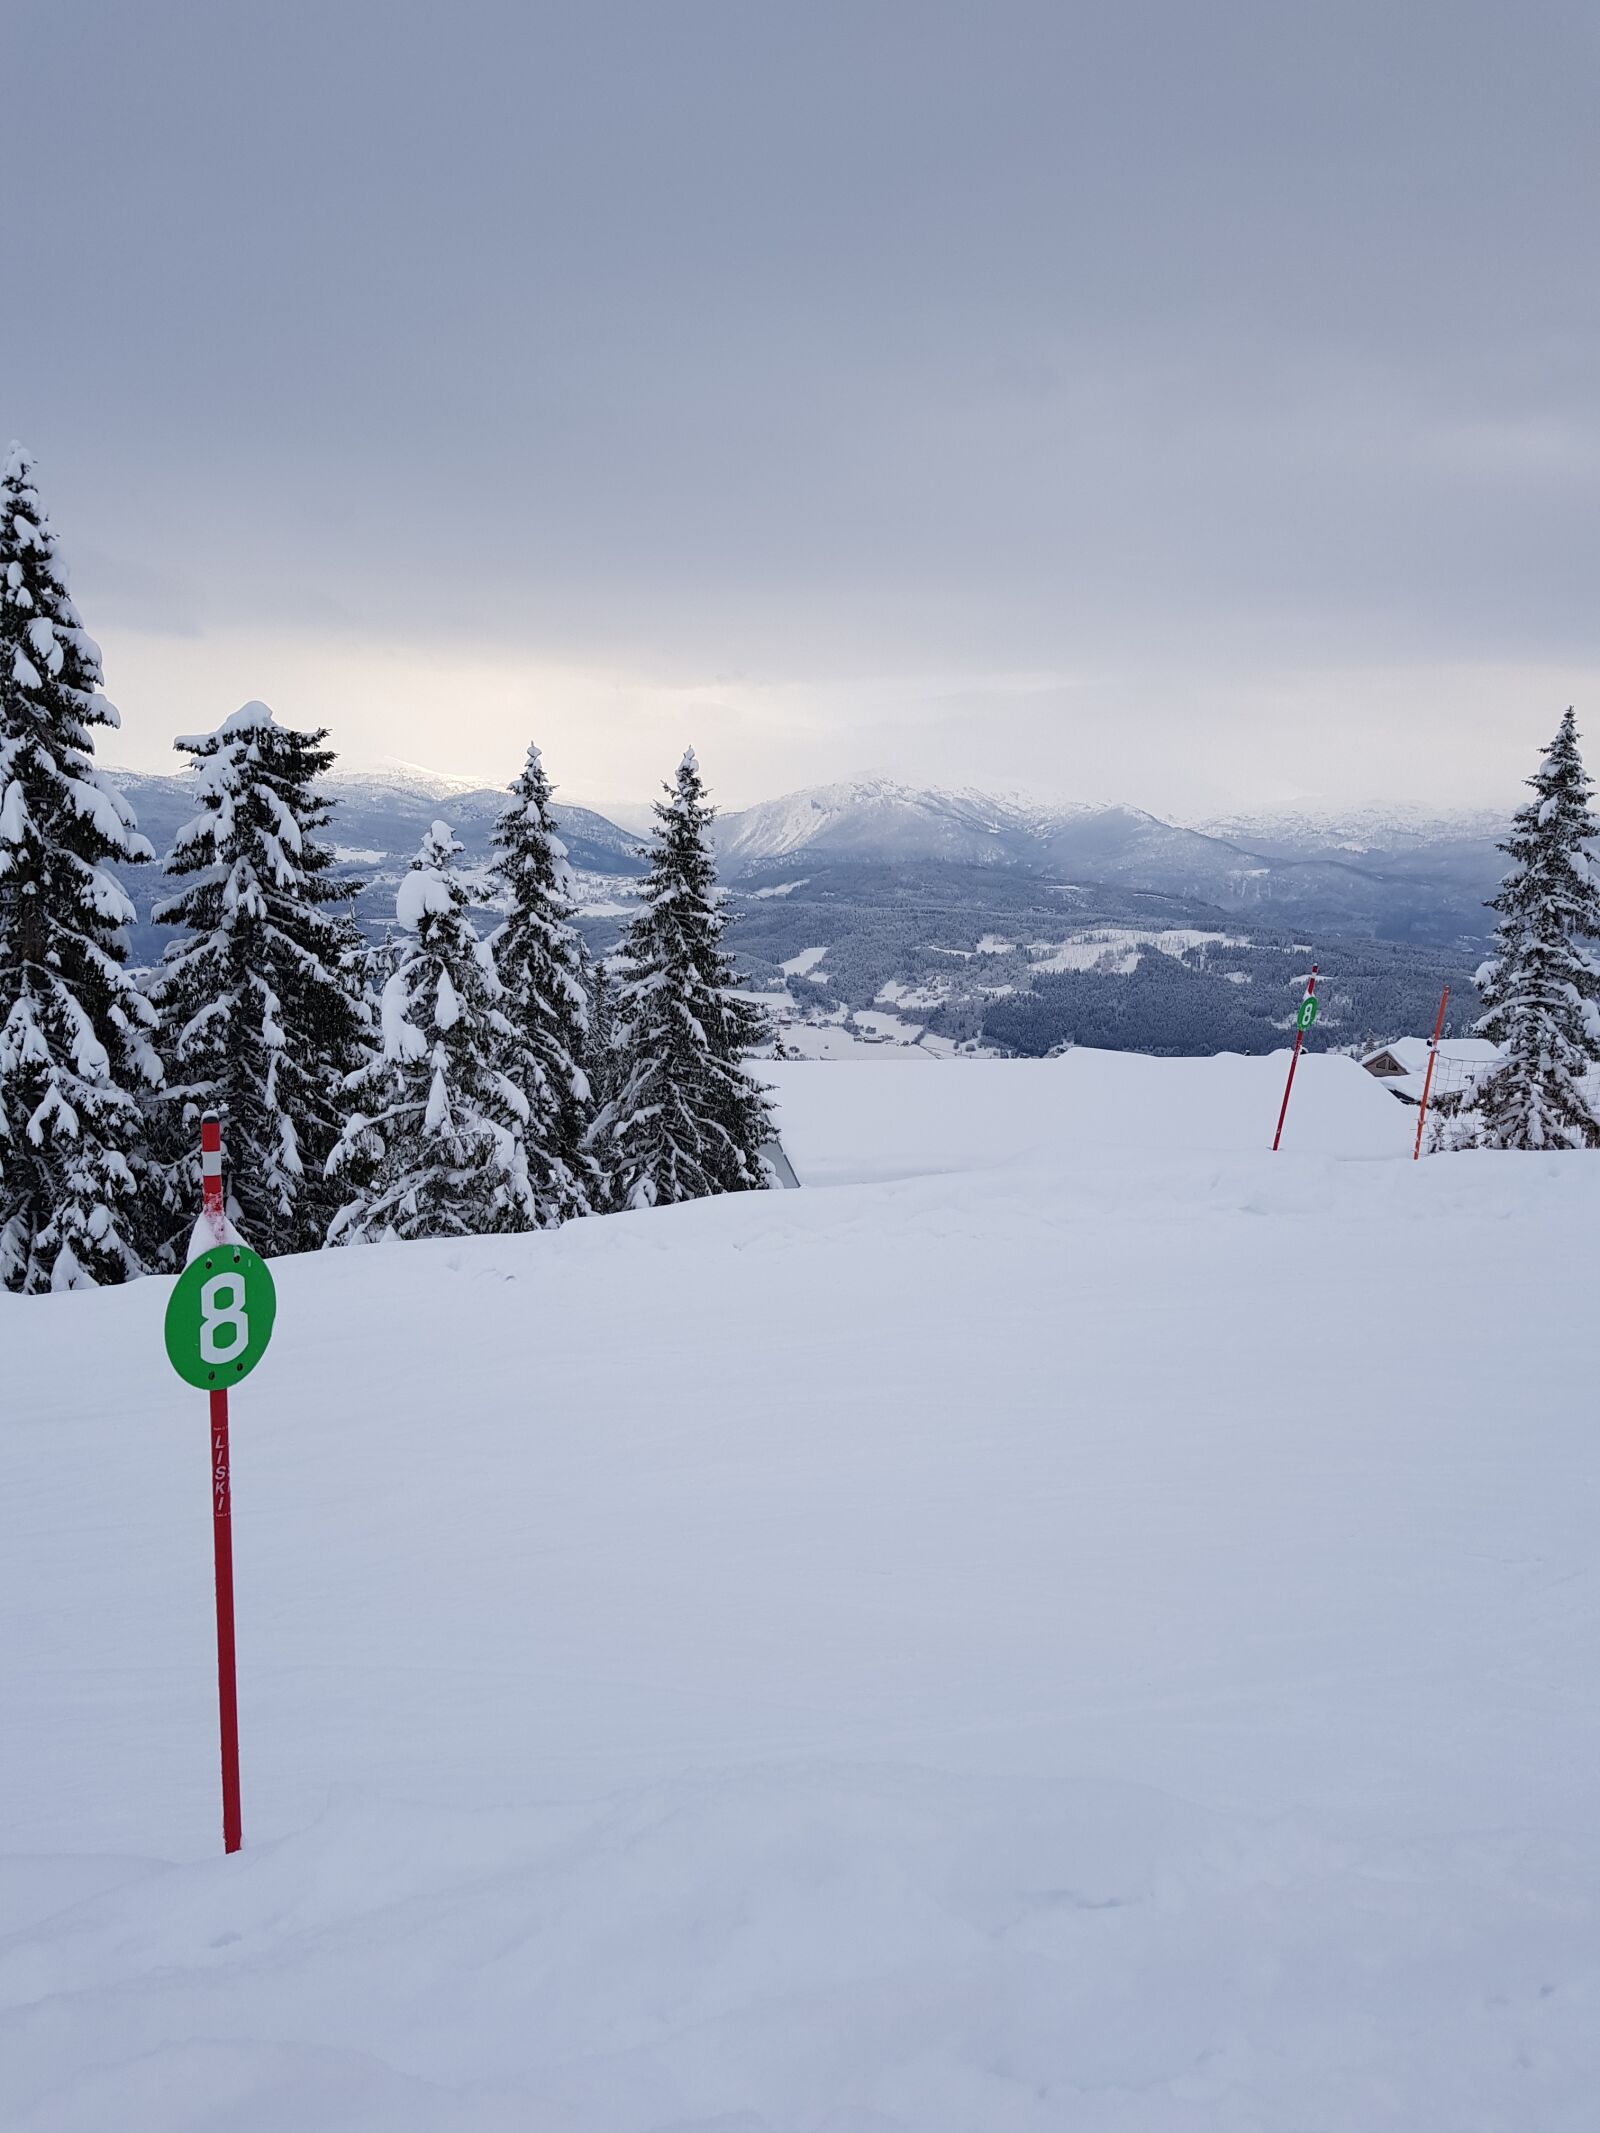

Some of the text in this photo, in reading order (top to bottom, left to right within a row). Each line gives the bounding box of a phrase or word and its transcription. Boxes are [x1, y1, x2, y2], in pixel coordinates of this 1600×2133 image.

[1302, 1003, 1313, 1026] 8
[200, 1272, 249, 1364] 8
[215, 1435, 227, 1511] LISKI
